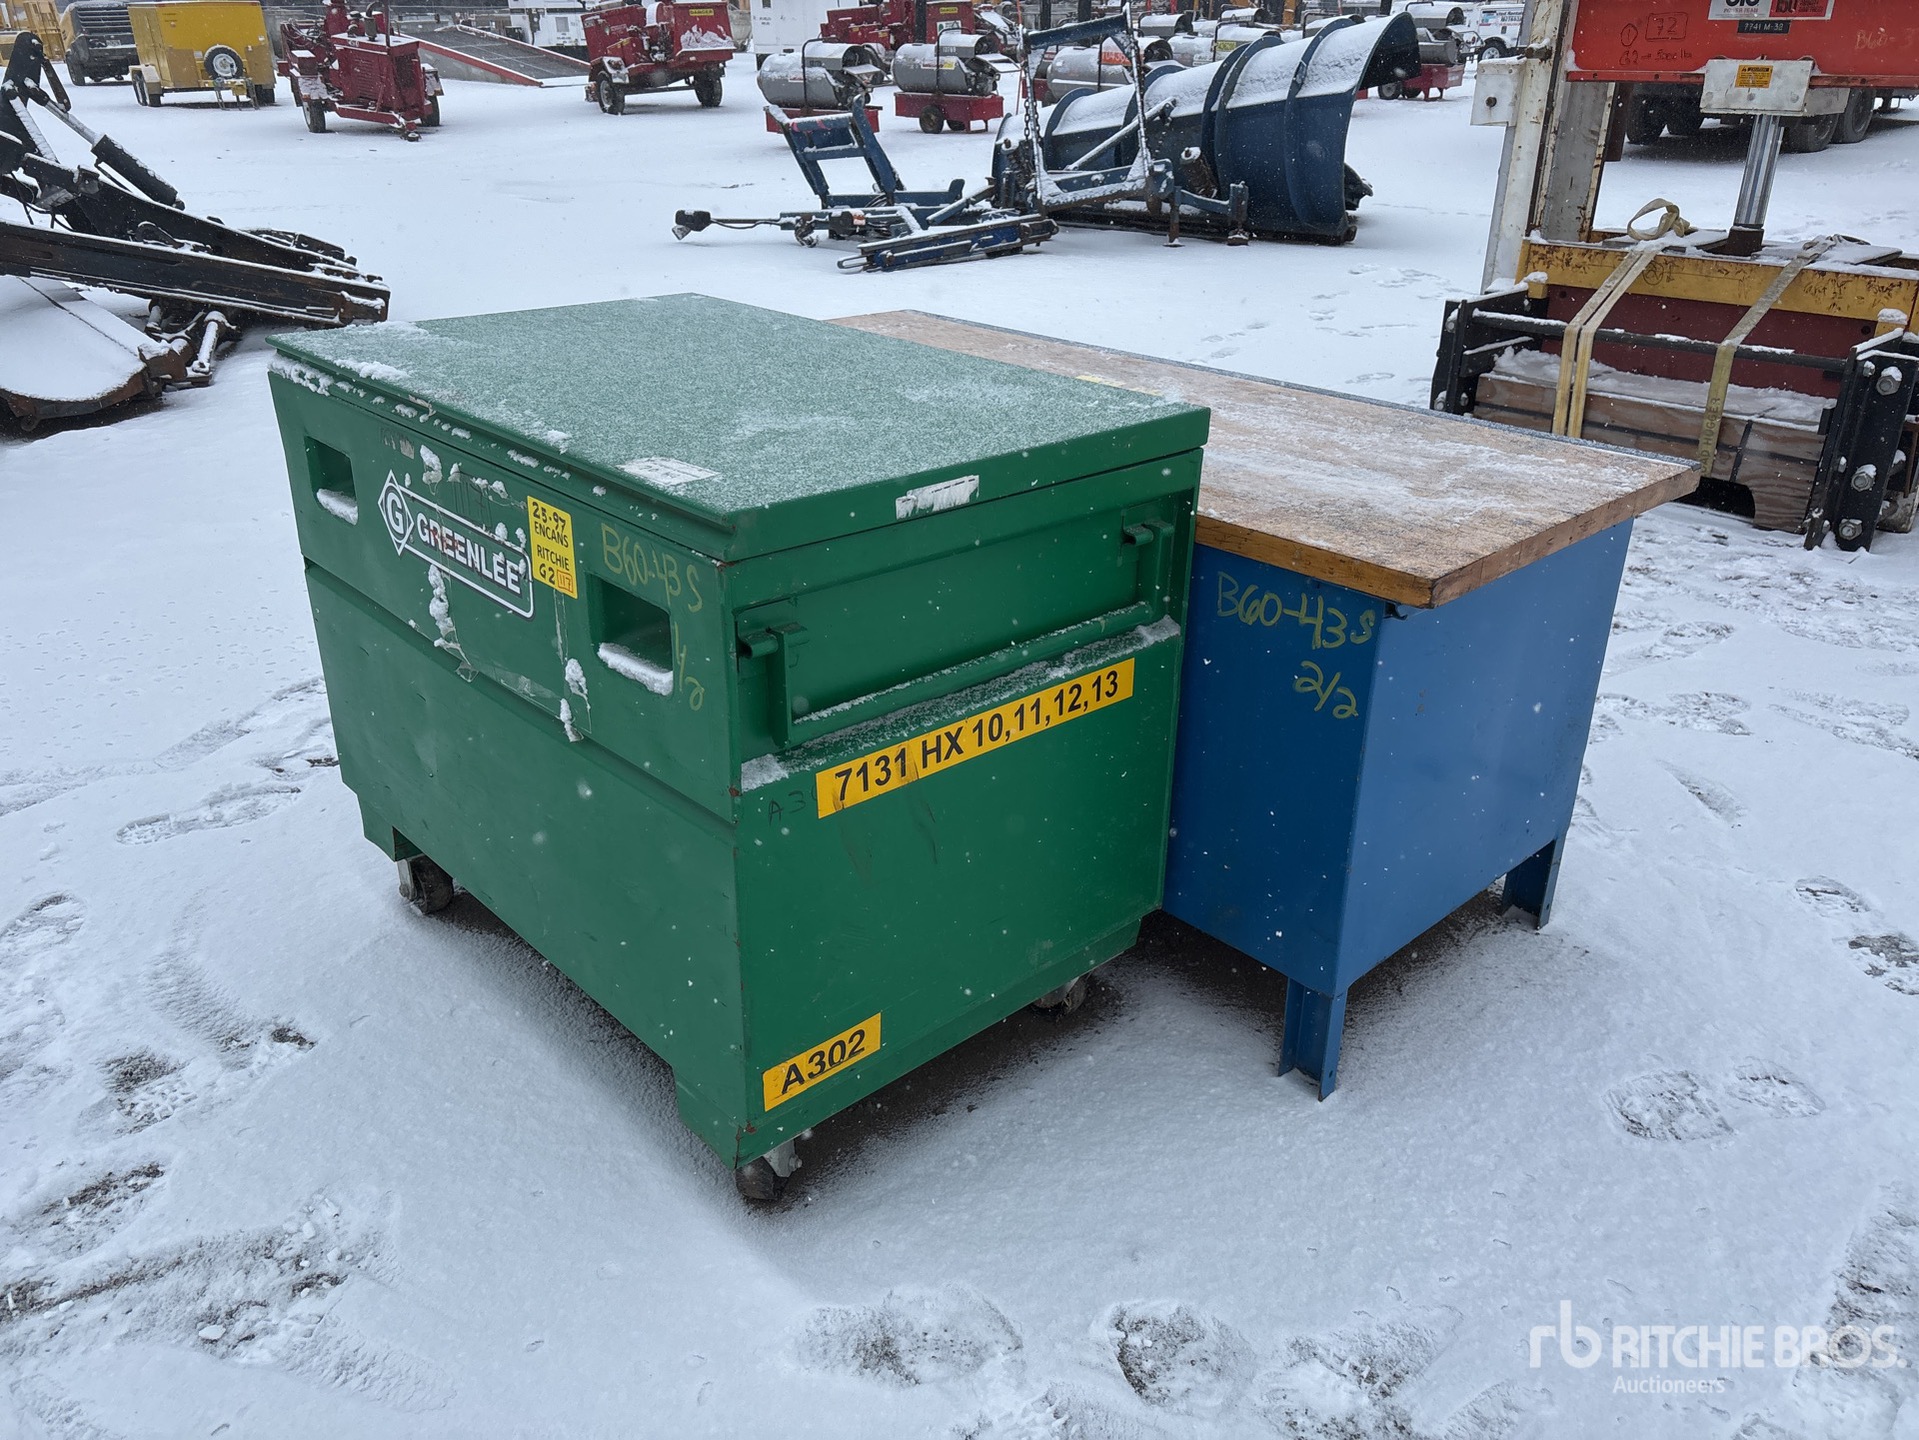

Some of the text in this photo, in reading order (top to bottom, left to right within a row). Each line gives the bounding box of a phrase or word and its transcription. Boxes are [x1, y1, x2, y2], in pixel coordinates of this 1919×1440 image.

[1703, 398, 1720, 446] HUGGER
[416, 512, 521, 595] GREENLEE
[534, 521, 569, 548] ENCANS
[537, 544, 570, 572] RITCHIE
[1217, 571, 1348, 650] B60-43
[1293, 660, 1359, 719] 2/2
[834, 747, 907, 801] 7131
[920, 726, 965, 769] HX
[781, 1028, 865, 1095] A302
